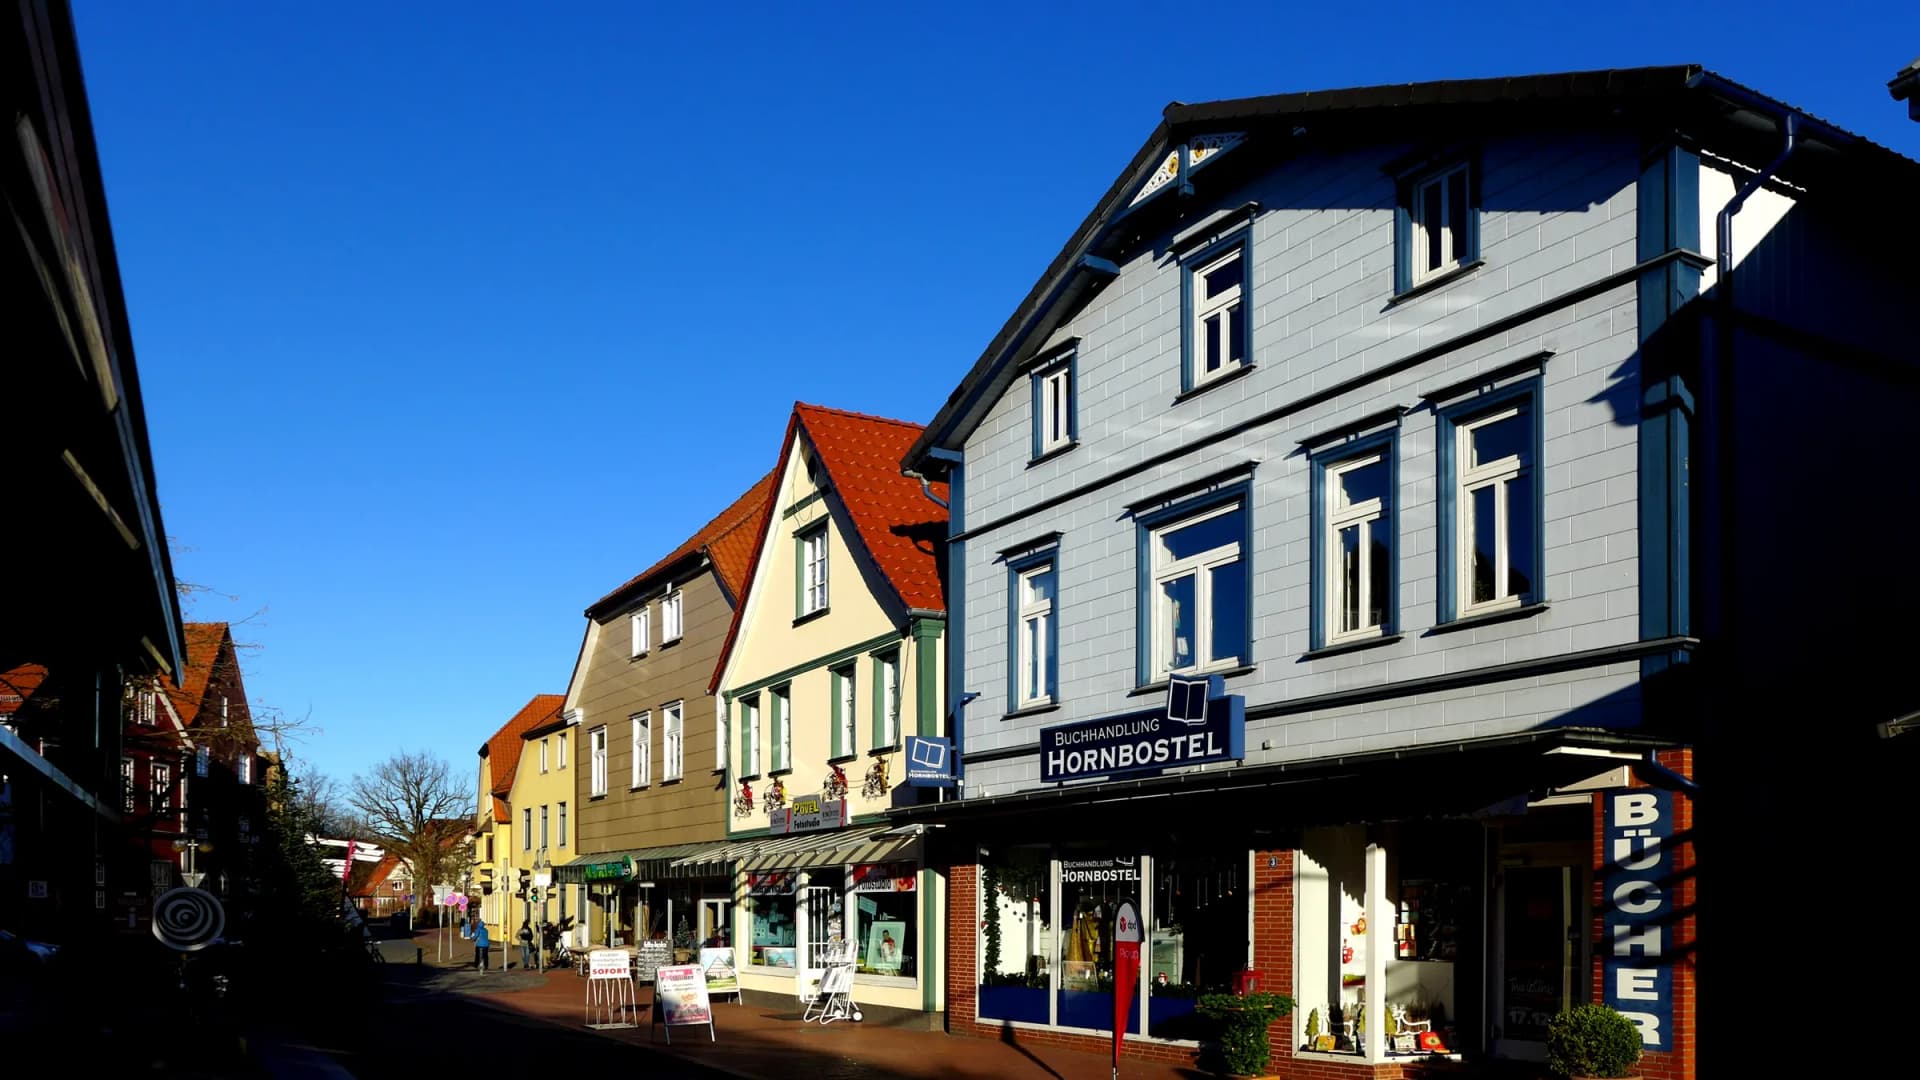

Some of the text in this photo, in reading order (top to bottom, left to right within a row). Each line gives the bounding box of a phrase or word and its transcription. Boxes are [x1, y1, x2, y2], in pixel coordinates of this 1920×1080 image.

[1055, 718, 1160, 747] BUCHHANDLUNG
[1047, 731, 1223, 777] HORNBOSTEL
[793, 800, 820, 816] POVEL
[1063, 860, 1114, 869] BUCHHANDLUNG
[1060, 868, 1141, 883] HORNBOSTEL
[1612, 793, 1662, 1046] BÜCHER
[592, 967, 627, 975] SOFORT
